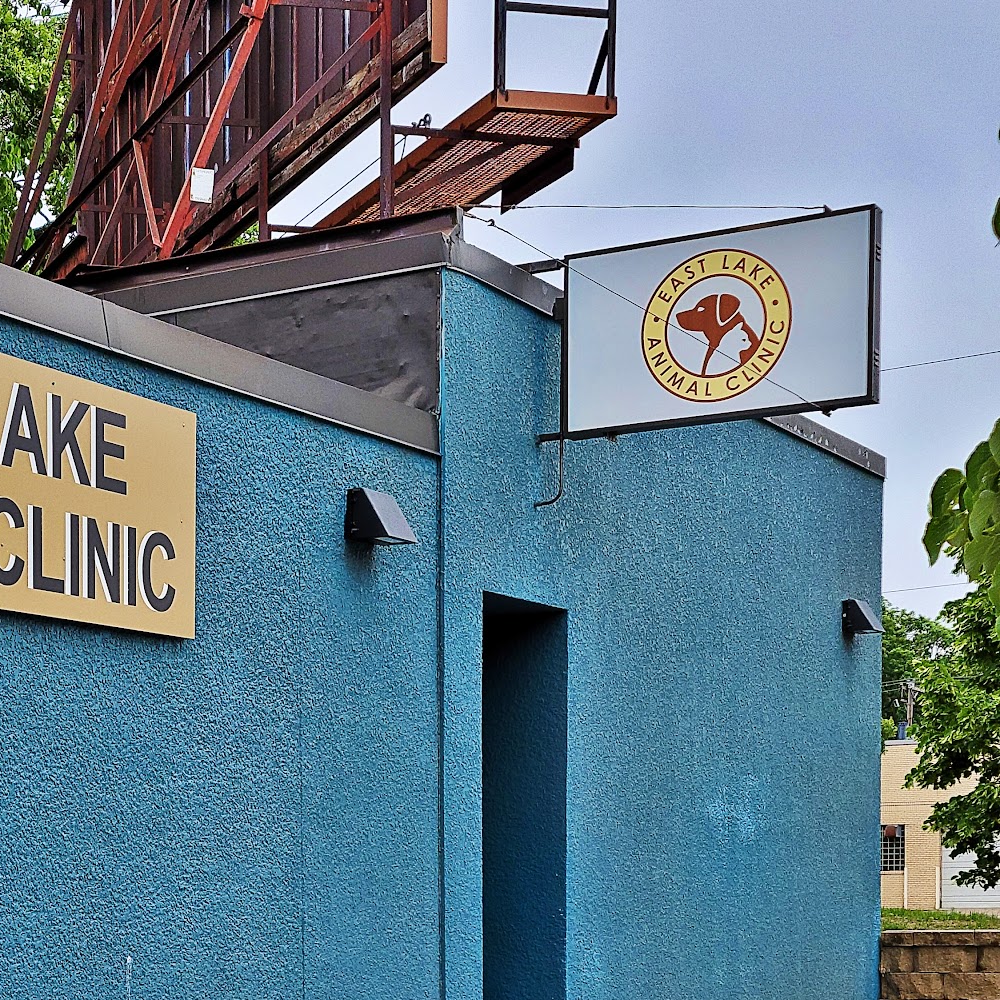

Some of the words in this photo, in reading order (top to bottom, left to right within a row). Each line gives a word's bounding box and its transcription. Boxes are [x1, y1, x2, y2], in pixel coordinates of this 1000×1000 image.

[658, 258, 707, 303] EAST
[722, 254, 775, 290] LAKE
[647, 337, 712, 397] ANIMAL
[726, 319, 785, 391] CLINIC
